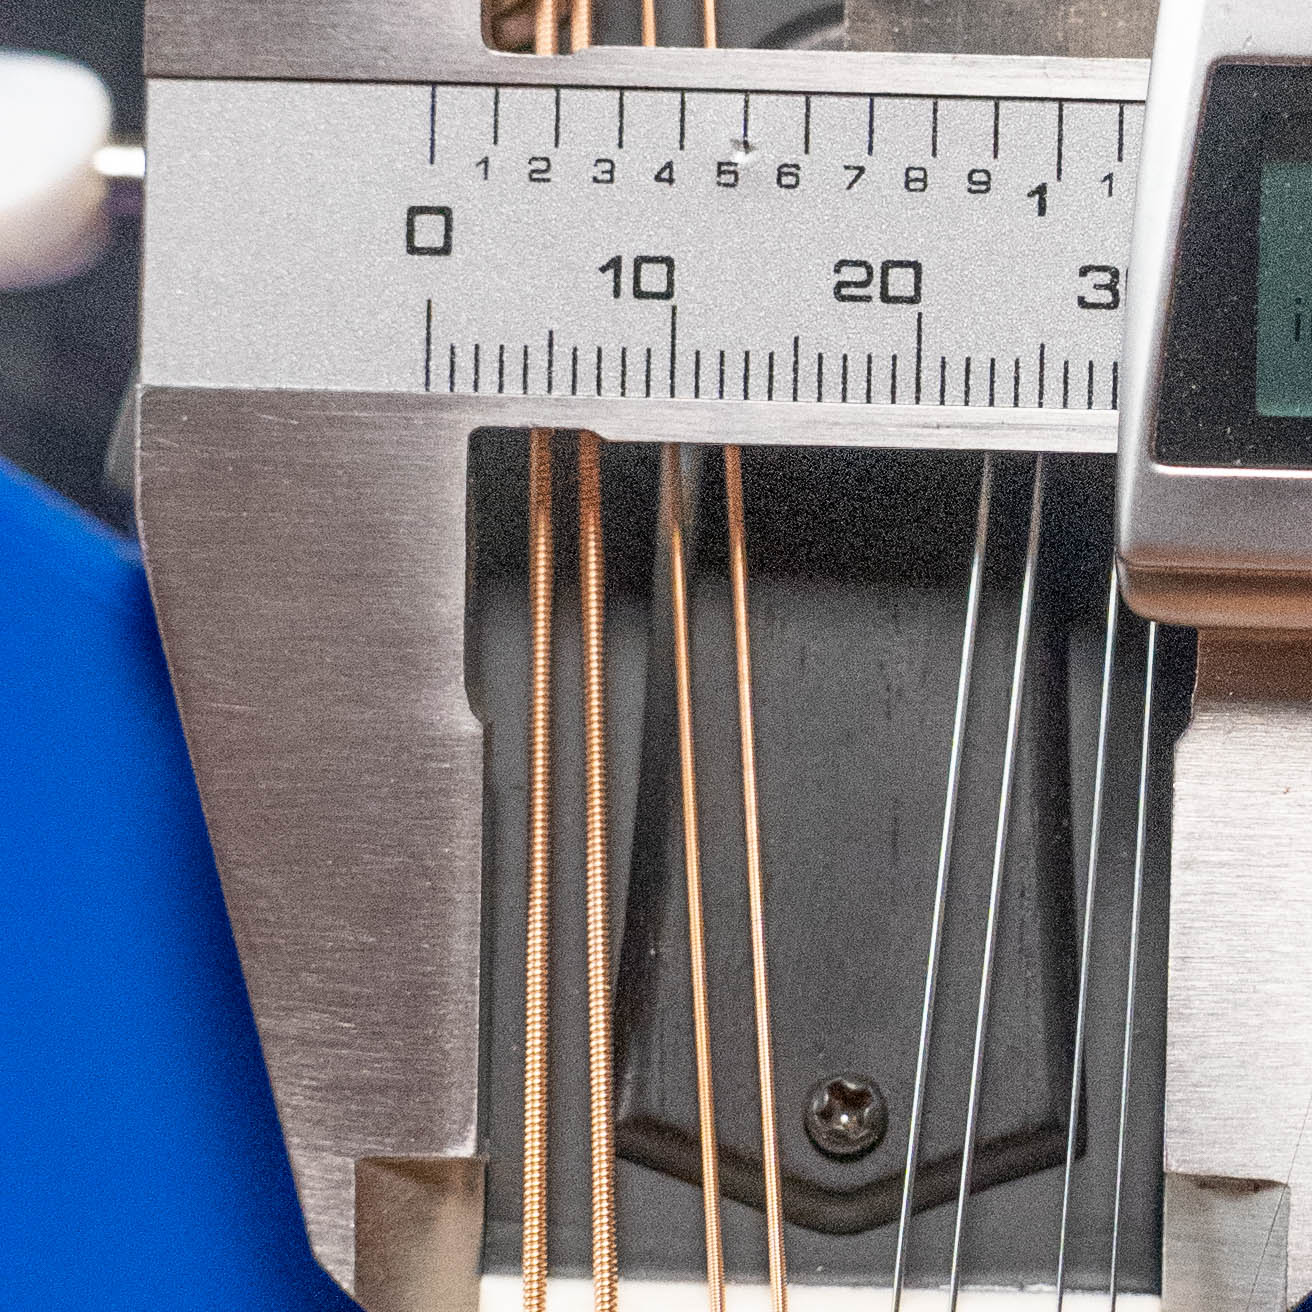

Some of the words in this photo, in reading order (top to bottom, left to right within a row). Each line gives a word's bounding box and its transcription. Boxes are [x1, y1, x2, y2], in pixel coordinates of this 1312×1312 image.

[475, 156, 489, 180] 1
[528, 156, 551, 183] 2
[592, 158, 615, 184] 3
[654, 160, 675, 186] 4
[716, 161, 740, 188] 5
[777, 163, 800, 189] 6
[843, 165, 866, 190] 7
[904, 166, 928, 192] 8
[967, 168, 991, 194] 9
[1027, 182, 1047, 217] 1
[1101, 172, 1114, 197] 1
[406, 205, 453, 256] 0
[599, 255, 675, 300] 10
[833, 259, 922, 304] 20
[1077, 264, 1129, 310] 3
